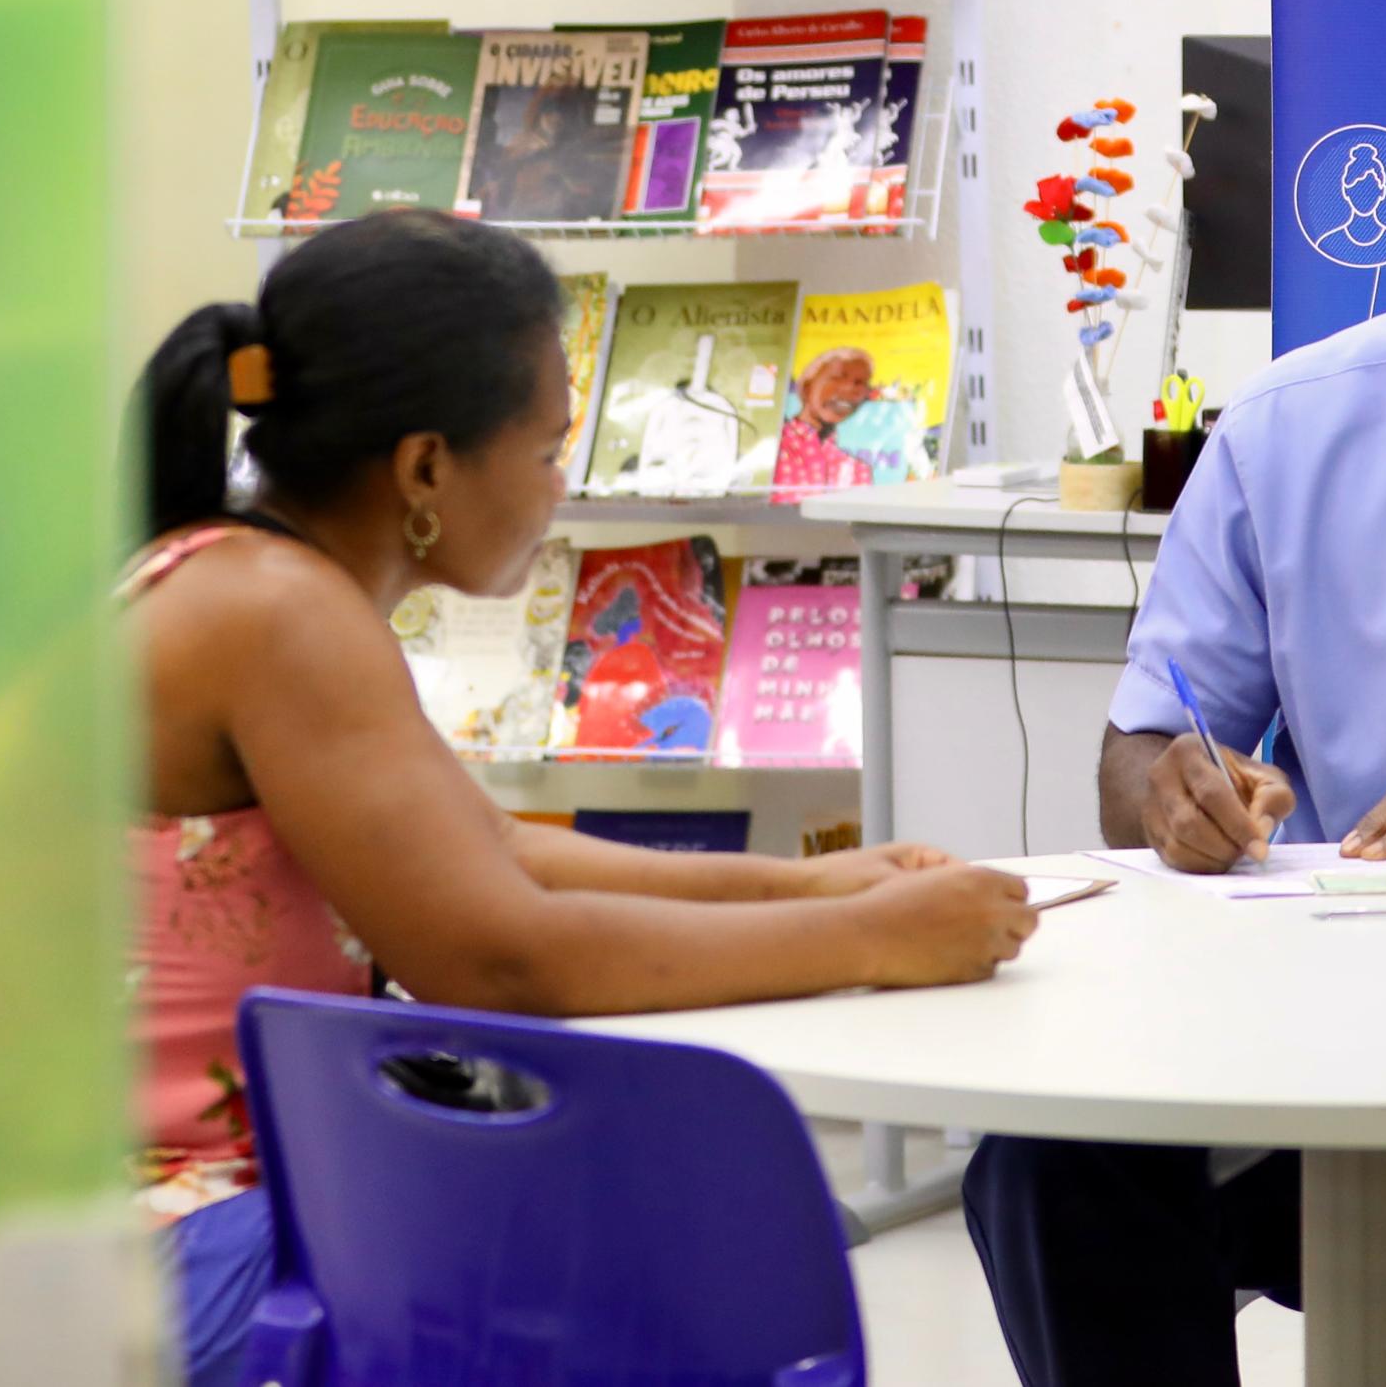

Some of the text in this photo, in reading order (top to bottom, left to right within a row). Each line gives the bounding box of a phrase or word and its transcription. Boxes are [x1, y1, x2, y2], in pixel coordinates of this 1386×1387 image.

[735, 67, 767, 84] Os
[770, 66, 856, 83] amores
[735, 82, 852, 102] de Perseu
[631, 302, 787, 328] O Alienista
[804, 296, 943, 325] MANDELA
